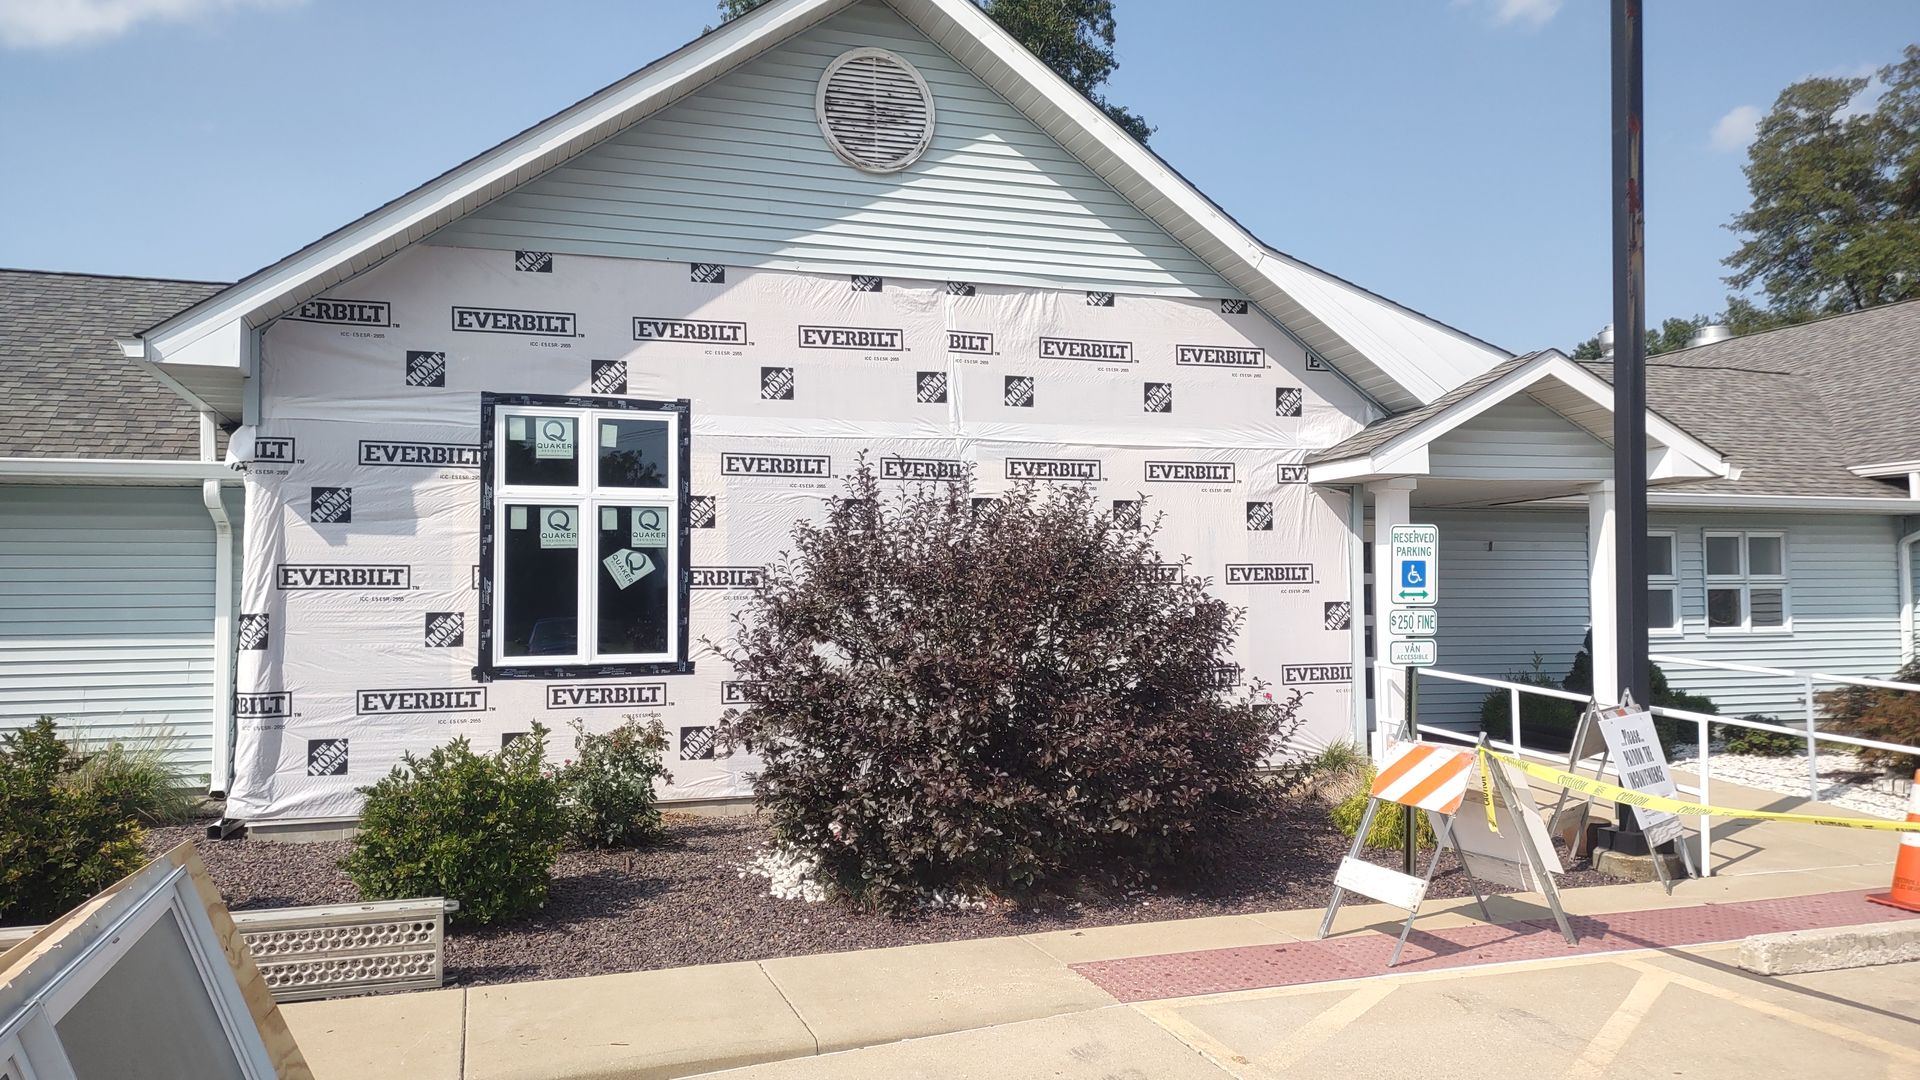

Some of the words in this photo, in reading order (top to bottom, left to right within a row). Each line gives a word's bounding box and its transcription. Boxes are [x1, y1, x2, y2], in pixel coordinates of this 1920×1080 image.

[864, 276, 880, 292] DEPO
[299, 301, 385, 323] ERBILT
[457, 310, 571, 333] EVERBILT
[637, 320, 742, 343] EVERBILT
[802, 329, 899, 348] EVERBILT
[1043, 341, 1129, 360] EVERBILT
[1179, 348, 1262, 366] EVERBILT
[407, 351, 445, 386] HOME
[410, 354, 427, 368] THE
[594, 363, 610, 376] THE
[421, 364, 445, 387] DEPOT
[591, 360, 627, 393] HOME
[605, 372, 627, 394] DEPOT
[761, 367, 794, 398] HOME
[764, 370, 778, 382] THE
[919, 374, 933, 386] THE
[773, 379, 794, 399] DEPOT
[917, 372, 947, 402] HOME
[928, 383, 947, 402] DEPOT
[1005, 376, 1034, 406] HOME
[1144, 382, 1172, 412] HOME
[1276, 387, 1302, 416] HOME
[726, 456, 826, 475] EVERBILT
[1010, 462, 1097, 478] EVERBILT
[1148, 464, 1232, 480] EVERBILT
[311, 487, 351, 522] HOME
[314, 490, 332, 504] THE
[326, 500, 351, 523] DEPOT
[1247, 502, 1273, 529] HOME
[1394, 533, 1434, 544] RESERVED
[1396, 547, 1432, 556] PARKING
[281, 568, 404, 586] EVERBILT
[612, 554, 634, 584] QUAKER
[1229, 566, 1310, 582] EVERBILT
[428, 615, 446, 629] THE
[1325, 602, 1350, 630] HOME
[1392, 615, 1414, 630] $250
[1418, 615, 1434, 629] FINE
[425, 612, 464, 646] HOME
[440, 625, 464, 647] DEPOT
[362, 690, 482, 712] EVERBILT
[552, 686, 662, 706] EVERBILT
[683, 729, 698, 742] THE
[308, 739, 348, 775] HOME
[311, 742, 329, 757] THE
[694, 739, 712, 760] DEPO
[323, 752, 348, 776] DEPOT
